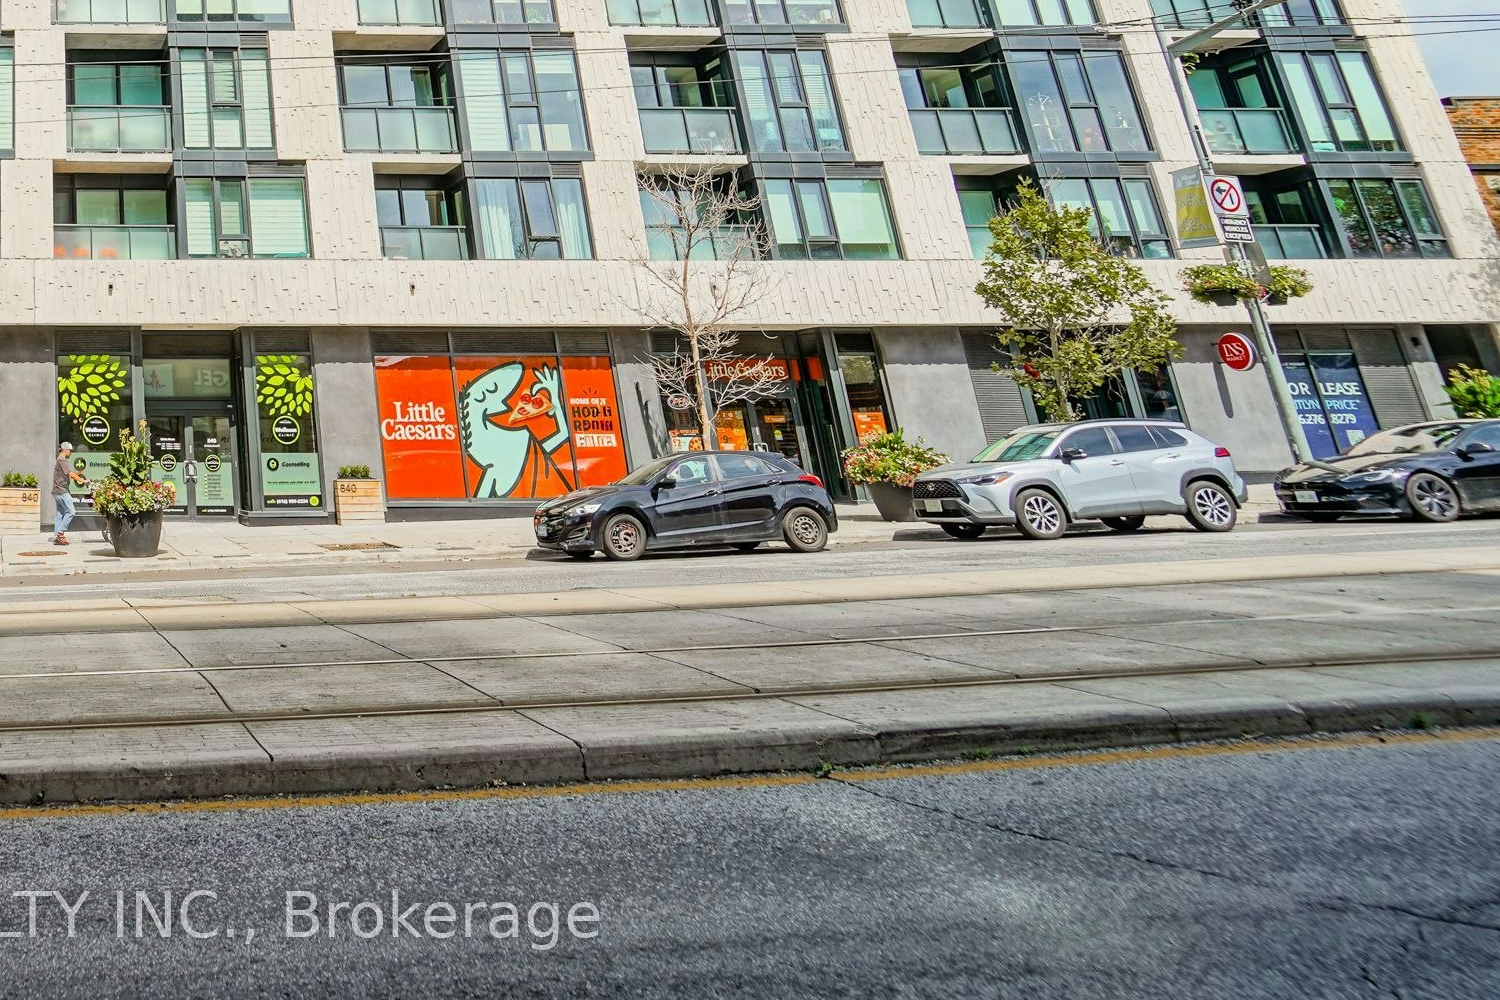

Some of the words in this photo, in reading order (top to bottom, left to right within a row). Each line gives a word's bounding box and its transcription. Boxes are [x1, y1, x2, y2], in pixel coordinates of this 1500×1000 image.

[1222, 342, 1245, 357] INS
[1287, 382, 1312, 396] OR
[1318, 382, 1362, 395] LEASE
[393, 401, 446, 423] Little
[381, 418, 456, 440] Caesars
[340, 483, 357, 493] 840
[22, 493, 39, 502] 840
